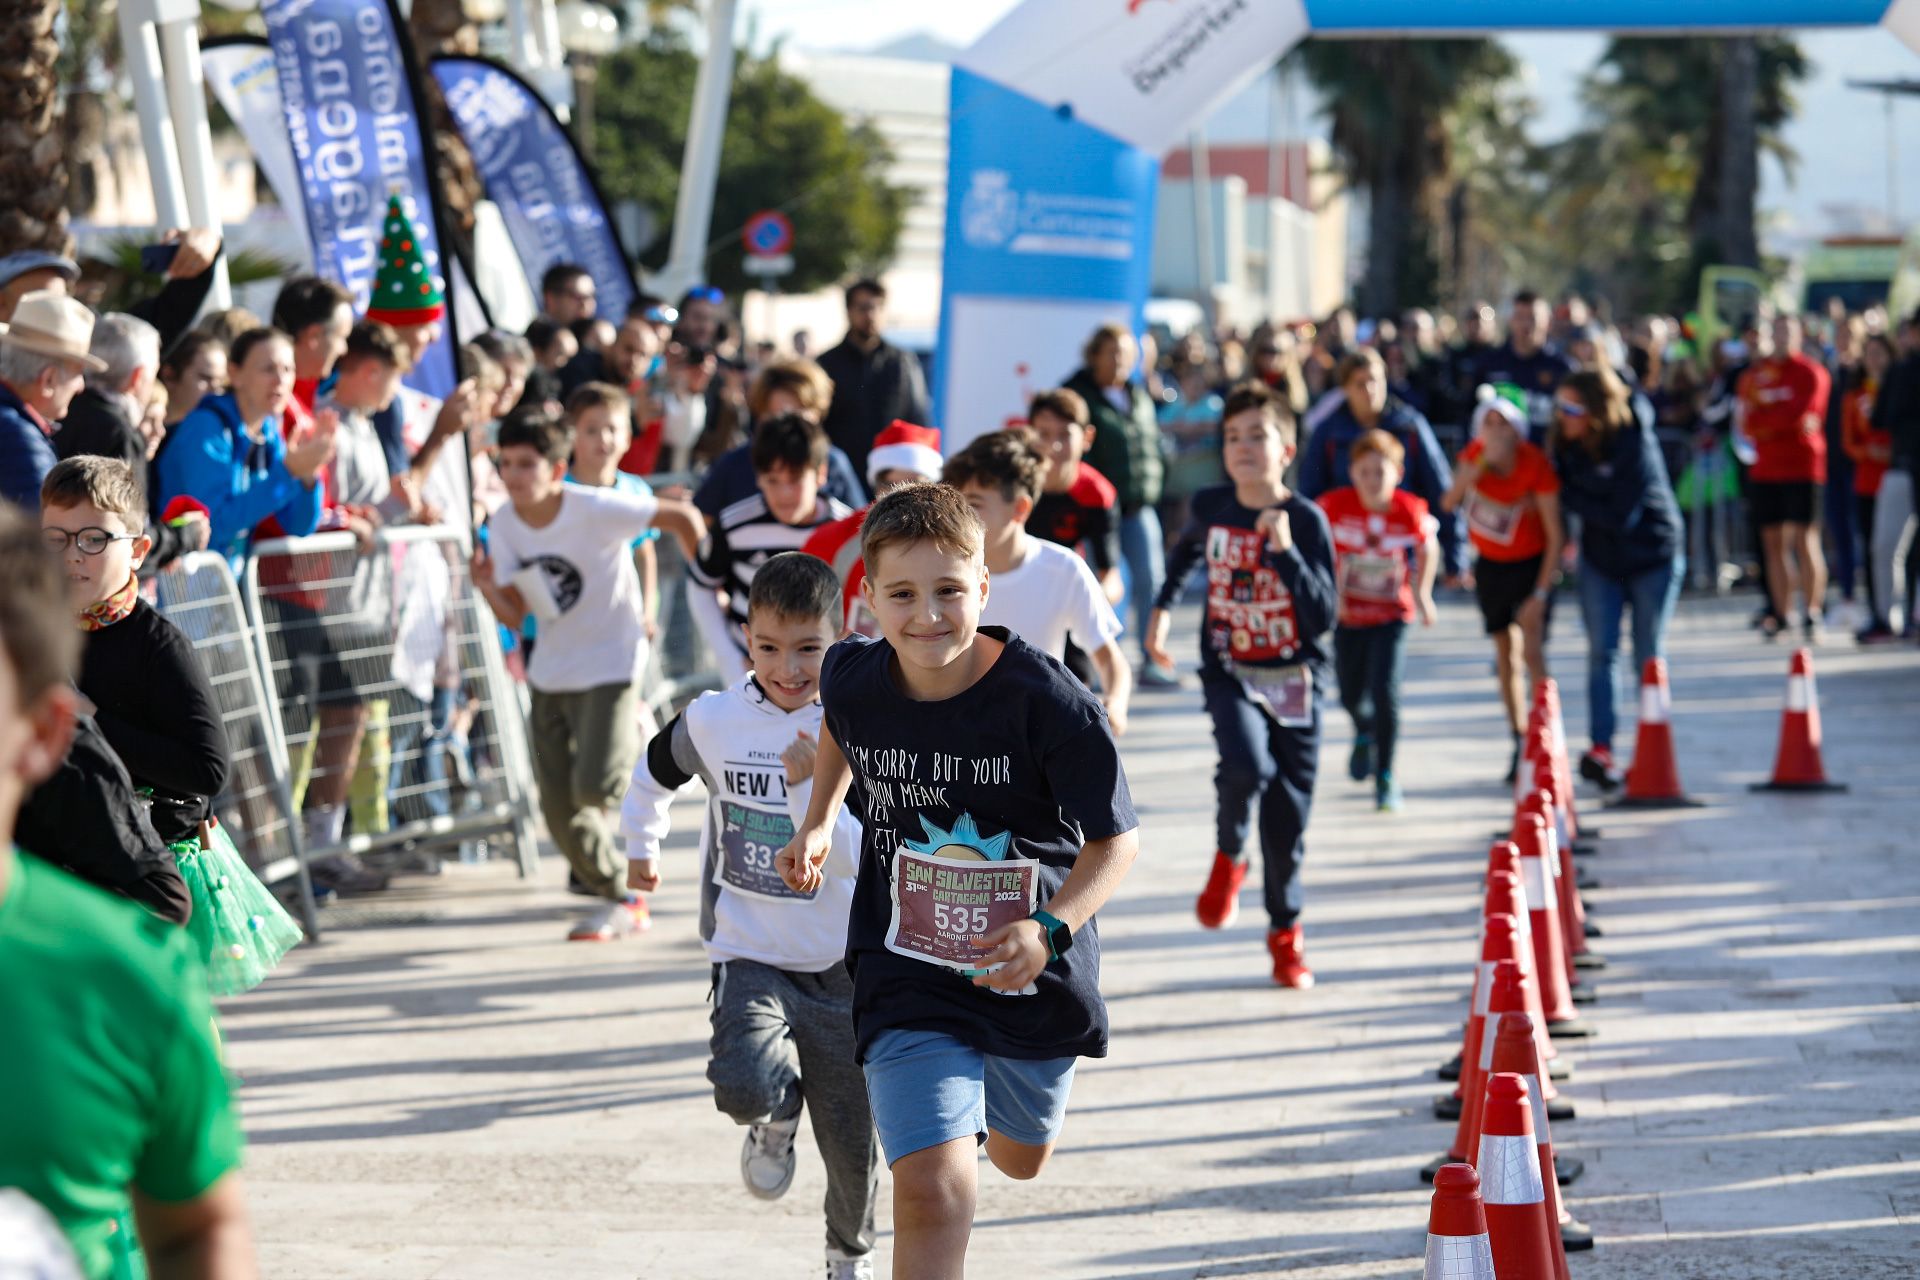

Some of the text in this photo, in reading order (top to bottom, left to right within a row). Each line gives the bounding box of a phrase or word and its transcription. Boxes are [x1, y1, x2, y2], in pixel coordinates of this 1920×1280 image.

[874, 748, 921, 784] SORRY,
[933, 752, 962, 782] BUT
[970, 755, 1010, 785] YOUR
[724, 770, 770, 798] NEW
[747, 813, 793, 834] SILVES
[906, 862, 1022, 891] SAN SILVESTRE
[906, 881, 917, 893] 31
[933, 889, 990, 905] CARTAGENA
[994, 891, 1021, 902] 2022
[934, 903, 989, 934] 535
